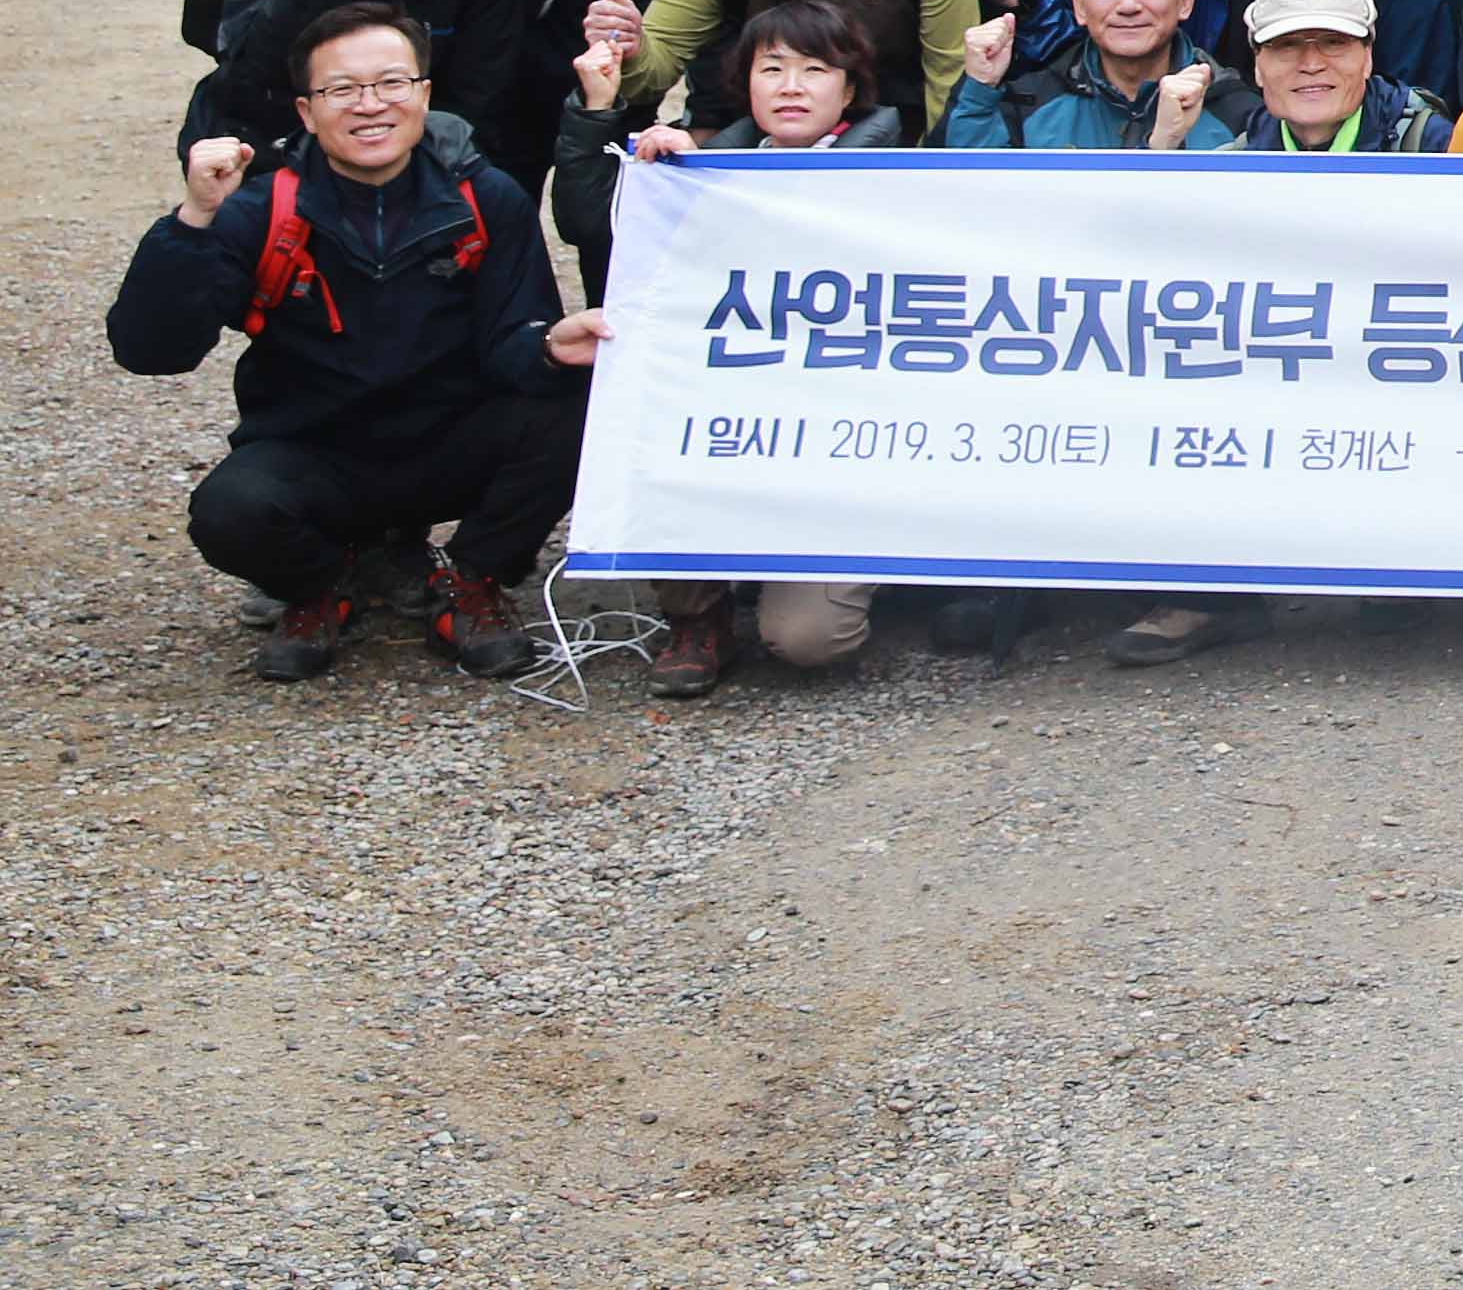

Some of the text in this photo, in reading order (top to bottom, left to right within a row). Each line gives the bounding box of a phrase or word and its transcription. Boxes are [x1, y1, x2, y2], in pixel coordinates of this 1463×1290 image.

[703, 269, 1333, 382] 산업통상자원부
[829, 419, 934, 461] 2019.
[950, 422, 982, 463] 3.
[998, 423, 1110, 466] 30(토)
[1300, 428, 1416, 472] 청계산
